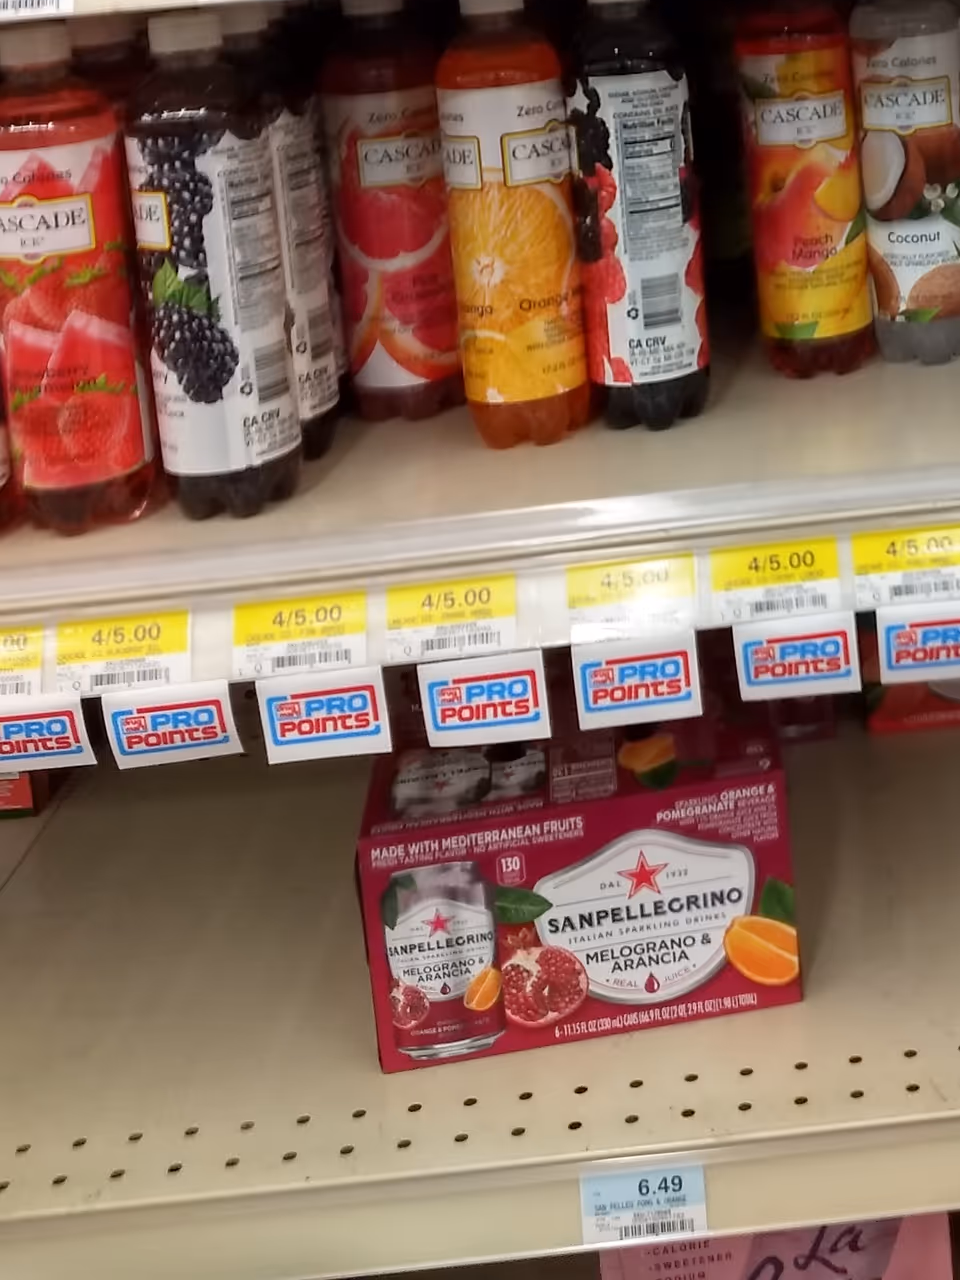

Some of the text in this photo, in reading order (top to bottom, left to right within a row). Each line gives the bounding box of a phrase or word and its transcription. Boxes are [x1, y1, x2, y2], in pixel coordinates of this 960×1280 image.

[891, 54, 938, 68] Calories
[516, 103, 544, 118] Zero
[863, 88, 946, 110] CASCADE
[367, 110, 398, 123] Zero
[759, 100, 845, 123] CASCADE
[887, 230, 941, 244] Coconut
[791, 246, 838, 261] Mango
[885, 535, 953, 557] 4/5.00
[748, 550, 815, 573] 4/5.00
[421, 587, 491, 609] 4/5.00
[272, 605, 343, 628] 4/5.00
[91, 623, 162, 646] 4/5.00
[778, 639, 841, 660] PRO
[617, 659, 681, 683] PRO
[753, 657, 842, 679] POINTS
[465, 678, 530, 702] PRO
[592, 679, 683, 705] POINTS
[305, 694, 368, 718] PRO
[440, 698, 530, 724] POINTS
[4, 719, 67, 738] PRO
[150, 708, 215, 729] PRO
[279, 713, 371, 738] POINTS
[126, 726, 218, 749] POINTS
[720, 786, 765, 801] ORANGE
[656, 801, 735, 822] POMEGRANATE
[370, 846, 405, 863] MADE
[408, 840, 440, 856] WITH
[442, 823, 541, 850] MEDITERRANEAN
[543, 816, 584, 835] FRUITS
[400, 853, 434, 864] TASTING
[435, 848, 467, 860] FLAVOR
[474, 845, 486, 855] NO
[488, 838, 530, 852] ARTIFICIAL
[532, 829, 584, 846] SWEETENERS
[500, 856, 521, 872] 130
[600, 880, 623, 890] DAL
[547, 887, 744, 934] SANPELLEGRINO
[568, 911, 728, 945] ITALIAN SPARKLING DRINKS
[387, 930, 495, 957] SANPELLEGRINO
[585, 932, 712, 965] MELOGRANO &
[402, 959, 476, 977] MELOGRANO
[610, 950, 690, 974] ARANCIA
[417, 968, 472, 983] ARANCIA
[612, 977, 639, 988] REAL
[637, 1174, 684, 1197] 6.49
[793, 1224, 866, 1274] La
